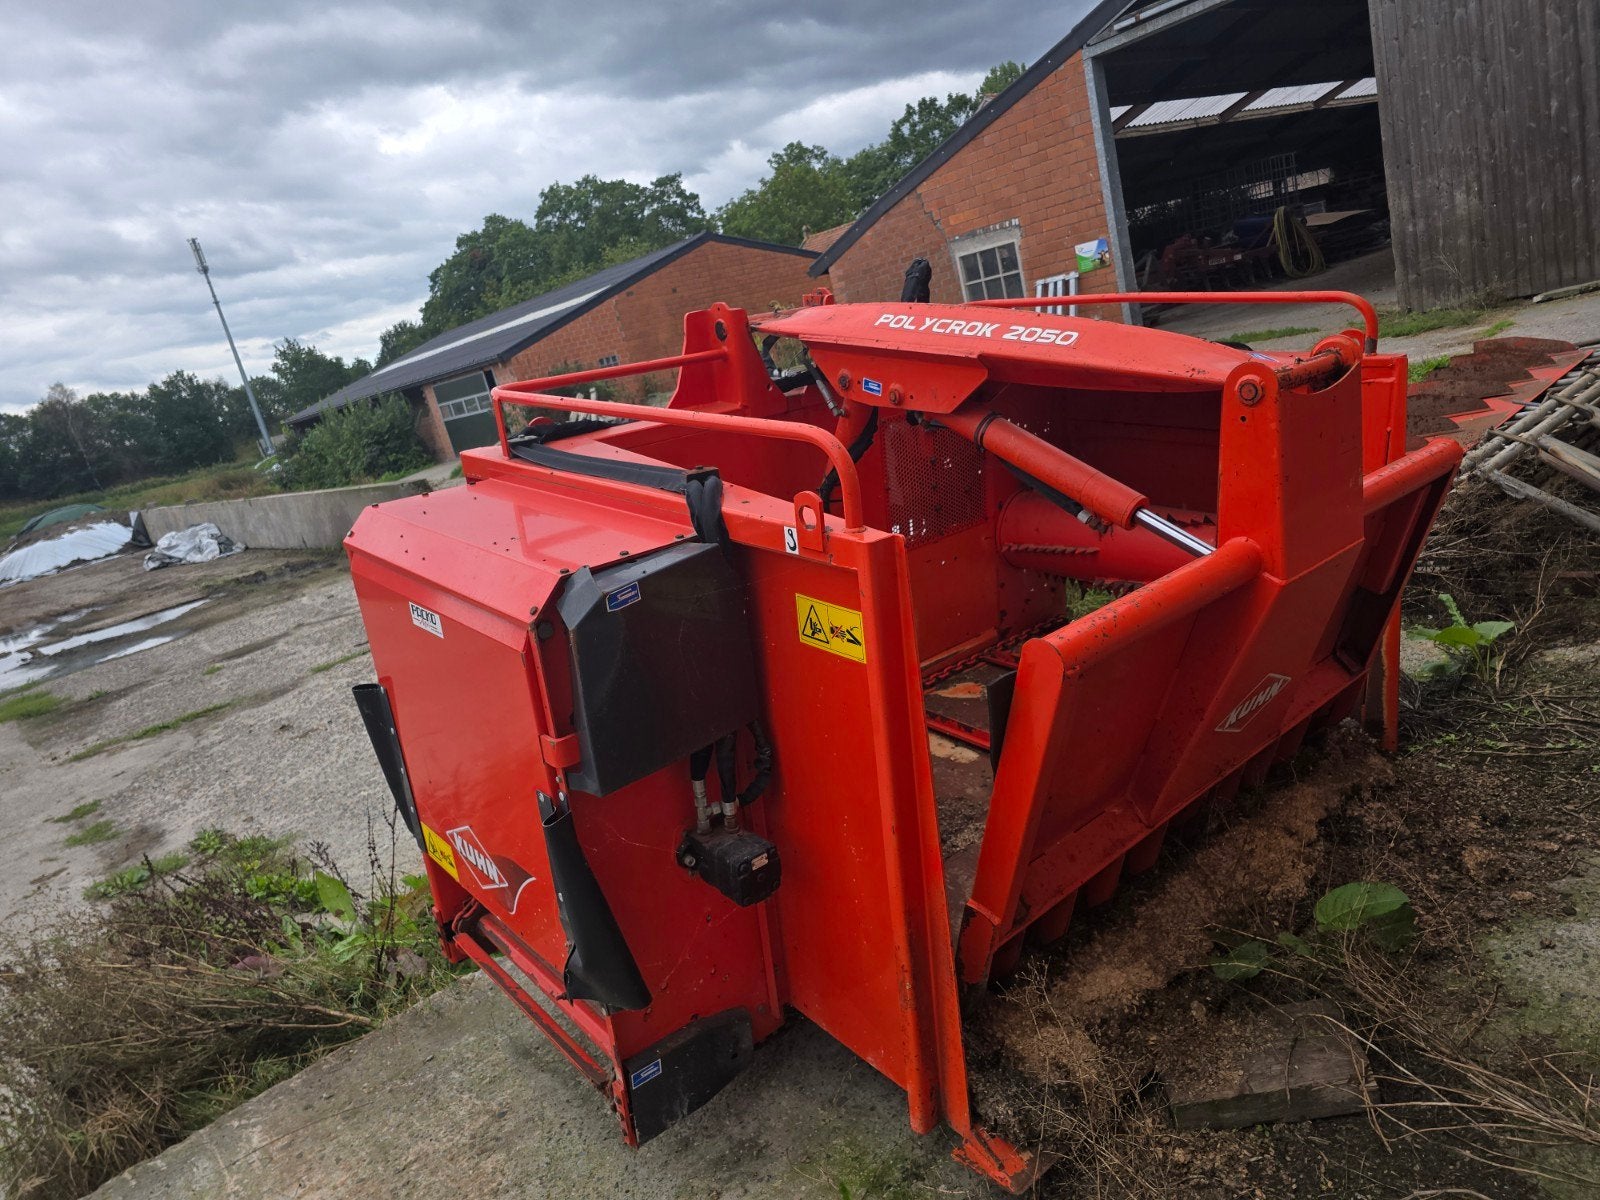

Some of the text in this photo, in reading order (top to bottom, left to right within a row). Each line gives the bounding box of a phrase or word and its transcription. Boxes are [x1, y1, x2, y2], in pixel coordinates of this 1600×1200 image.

[874, 313, 1079, 346] POLYCROK 2050
[1224, 677, 1285, 731] KUHN
[453, 830, 501, 887] KUHN
